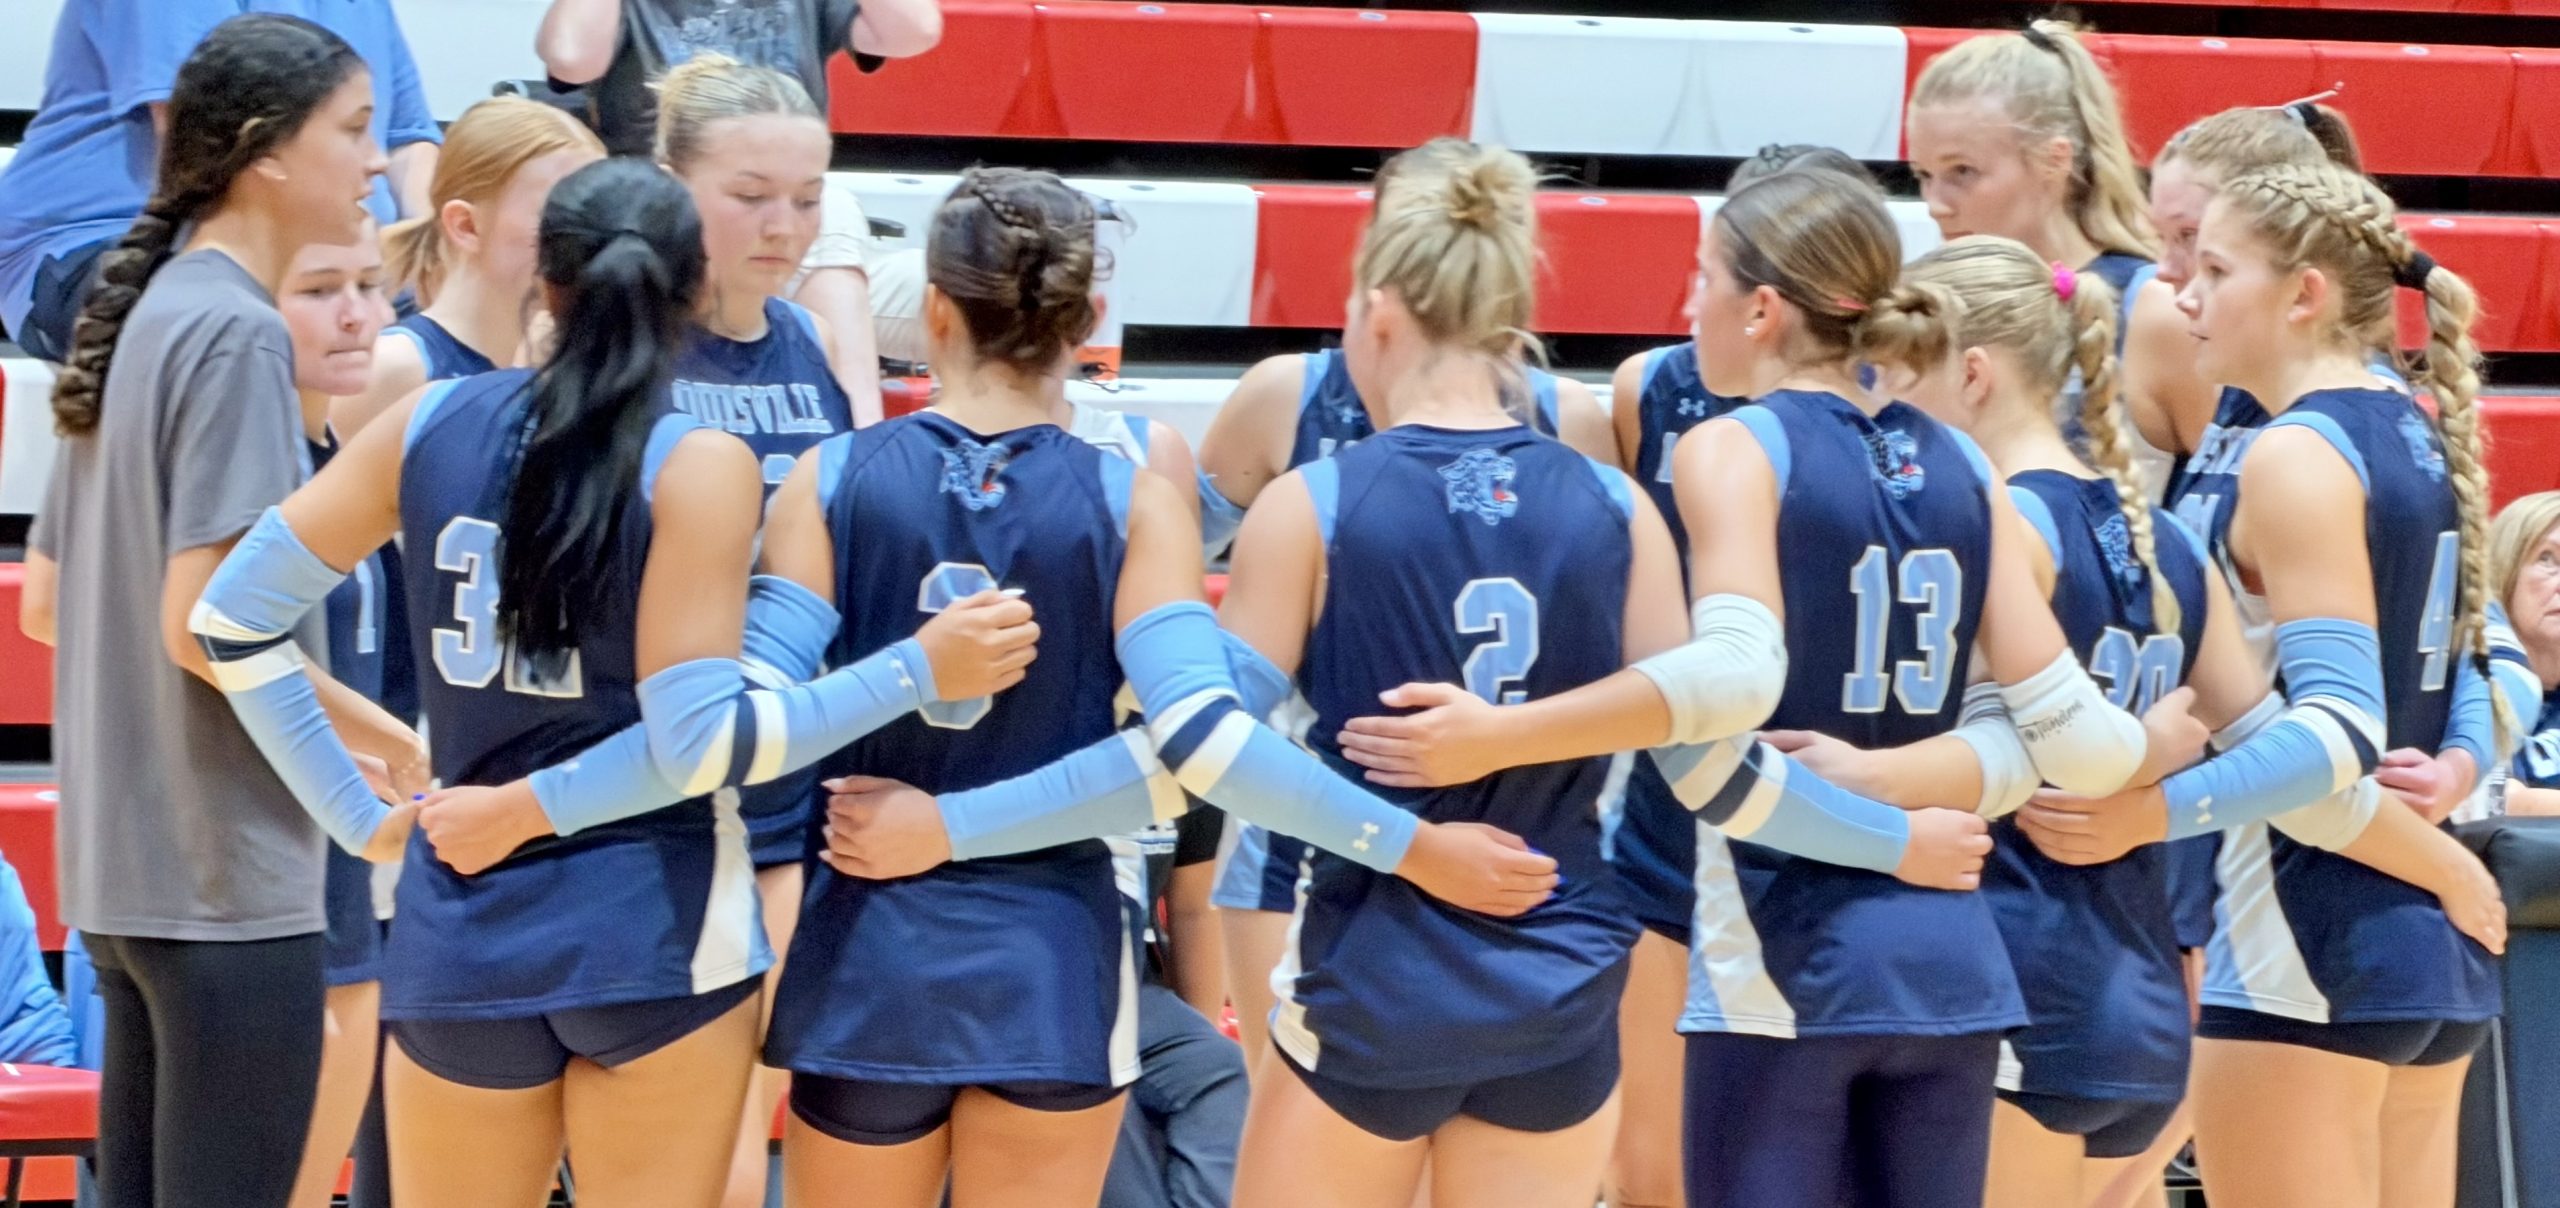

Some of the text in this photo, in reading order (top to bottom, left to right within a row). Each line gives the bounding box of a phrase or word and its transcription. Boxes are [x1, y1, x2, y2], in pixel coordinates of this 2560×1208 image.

[671, 378, 835, 434] OUISVILLE
[1453, 577, 1539, 706] 2
[1841, 545, 1962, 714] 13
[2416, 530, 2460, 691] 4
